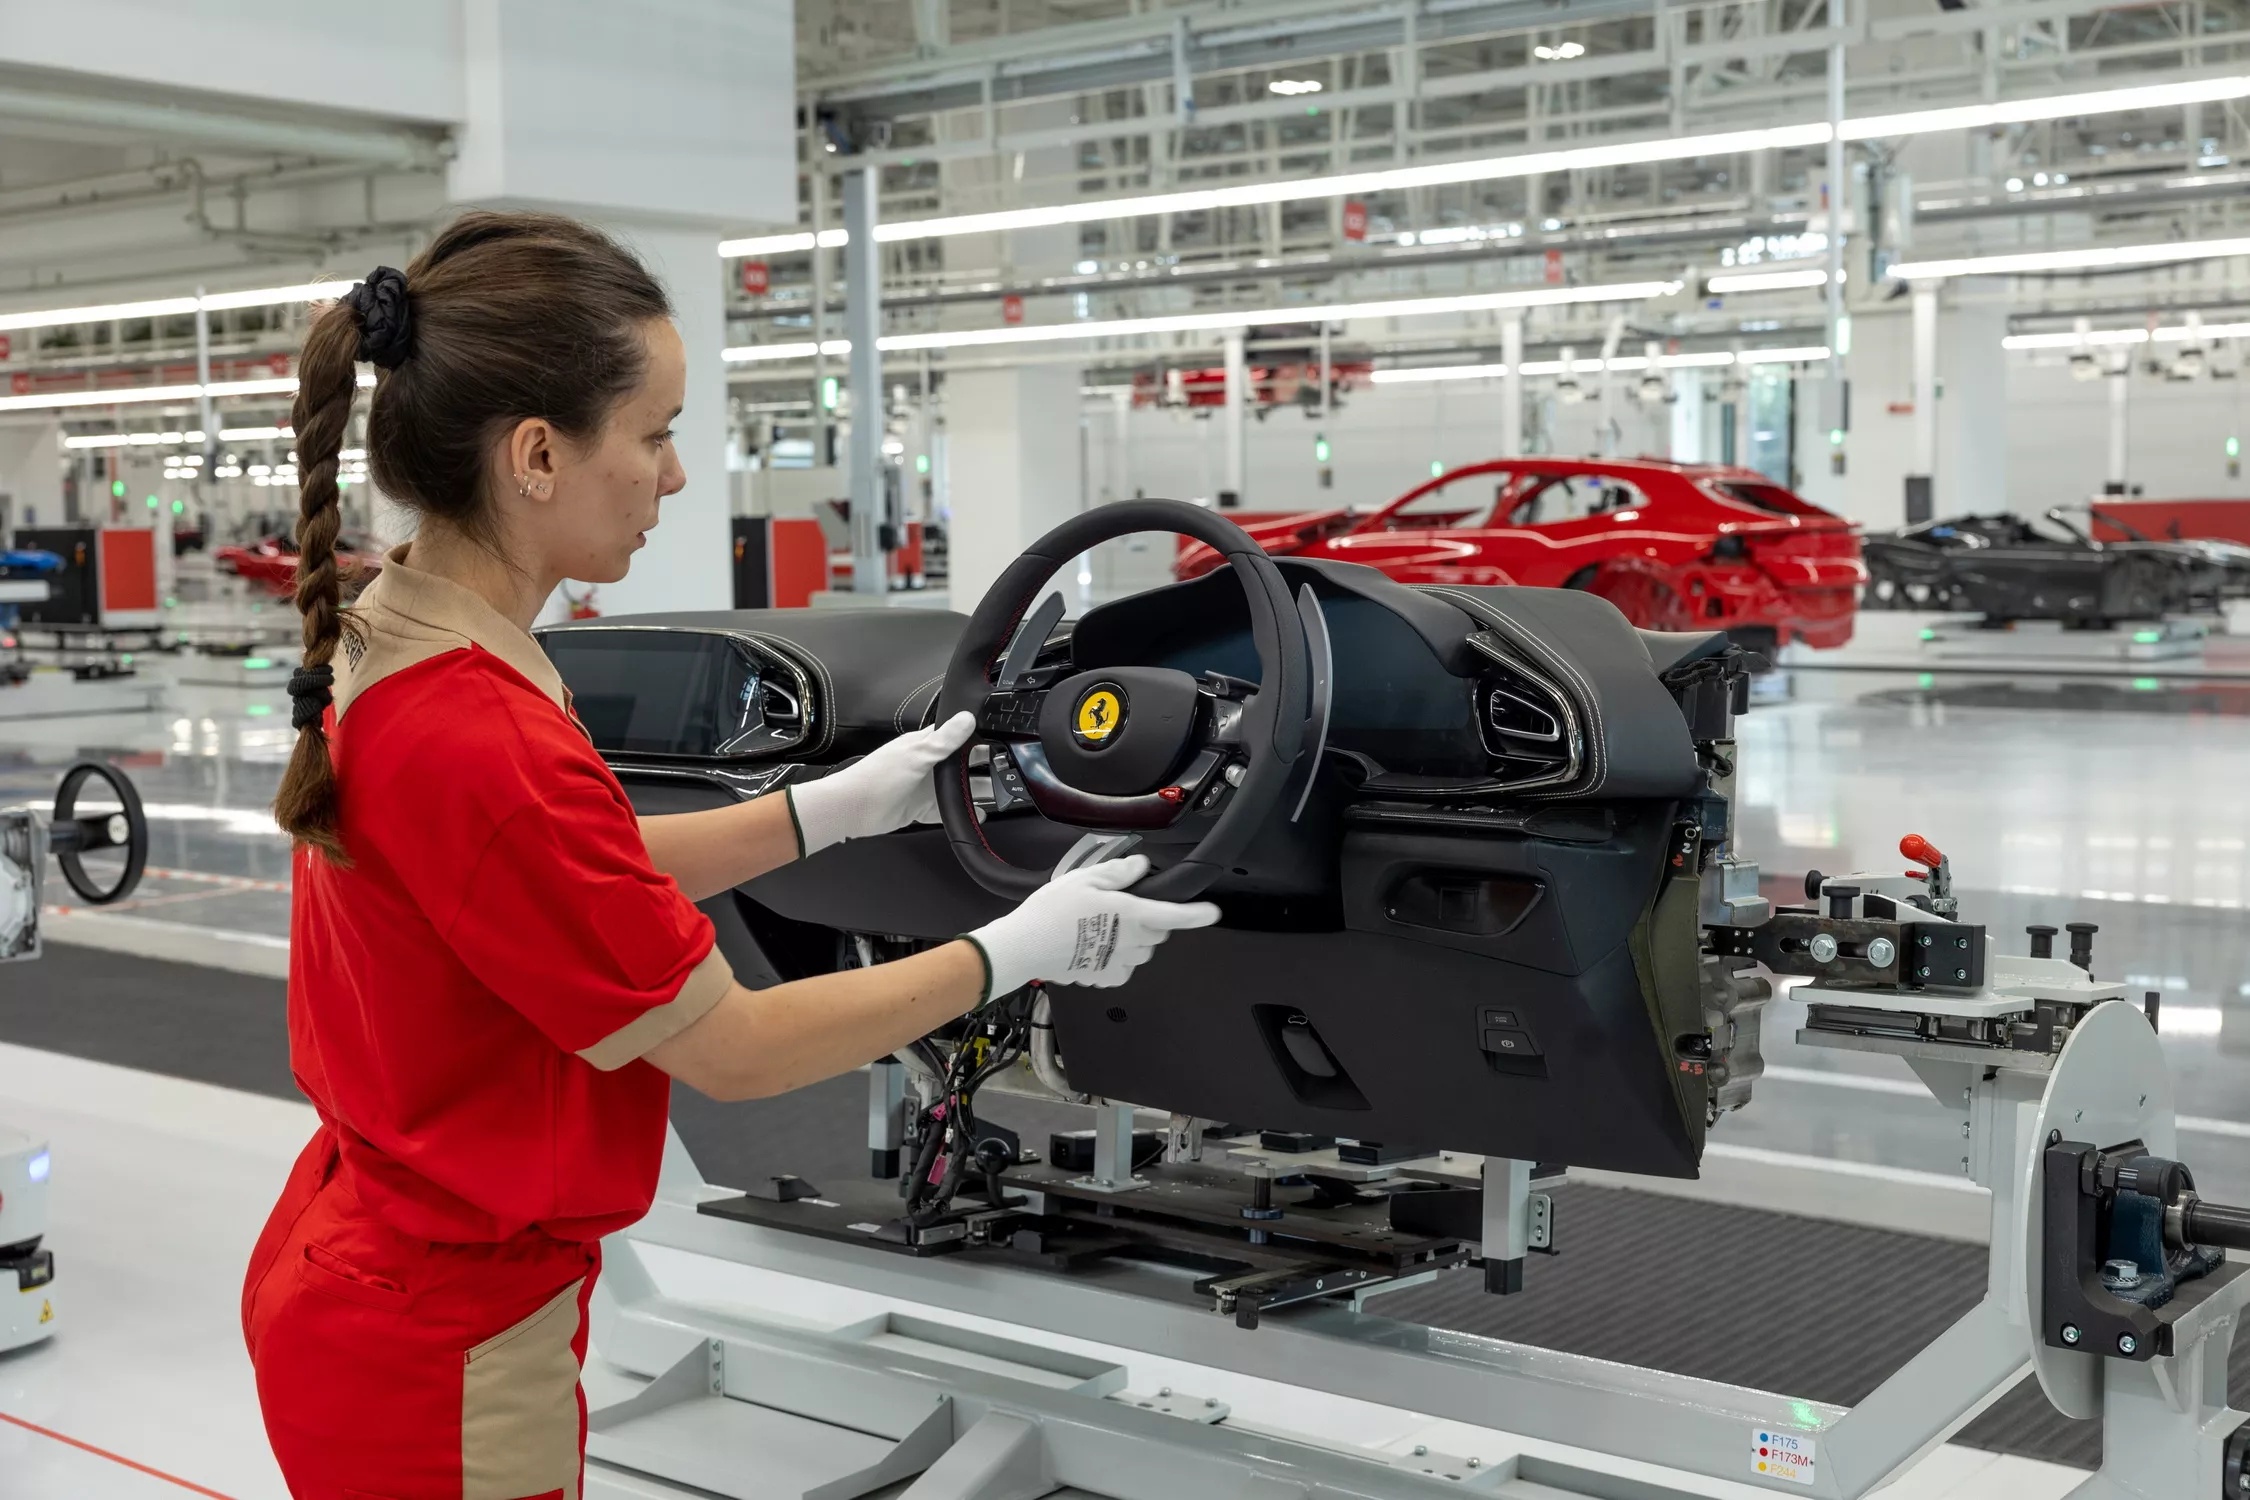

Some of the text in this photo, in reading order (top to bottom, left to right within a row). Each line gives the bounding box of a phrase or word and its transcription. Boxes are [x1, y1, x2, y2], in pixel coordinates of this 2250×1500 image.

[1681, 842, 1693, 854] 2
[1771, 1434, 1799, 1450] F175
[1771, 1449, 1808, 1467] F173M
[1770, 1463, 1797, 1478] F244
